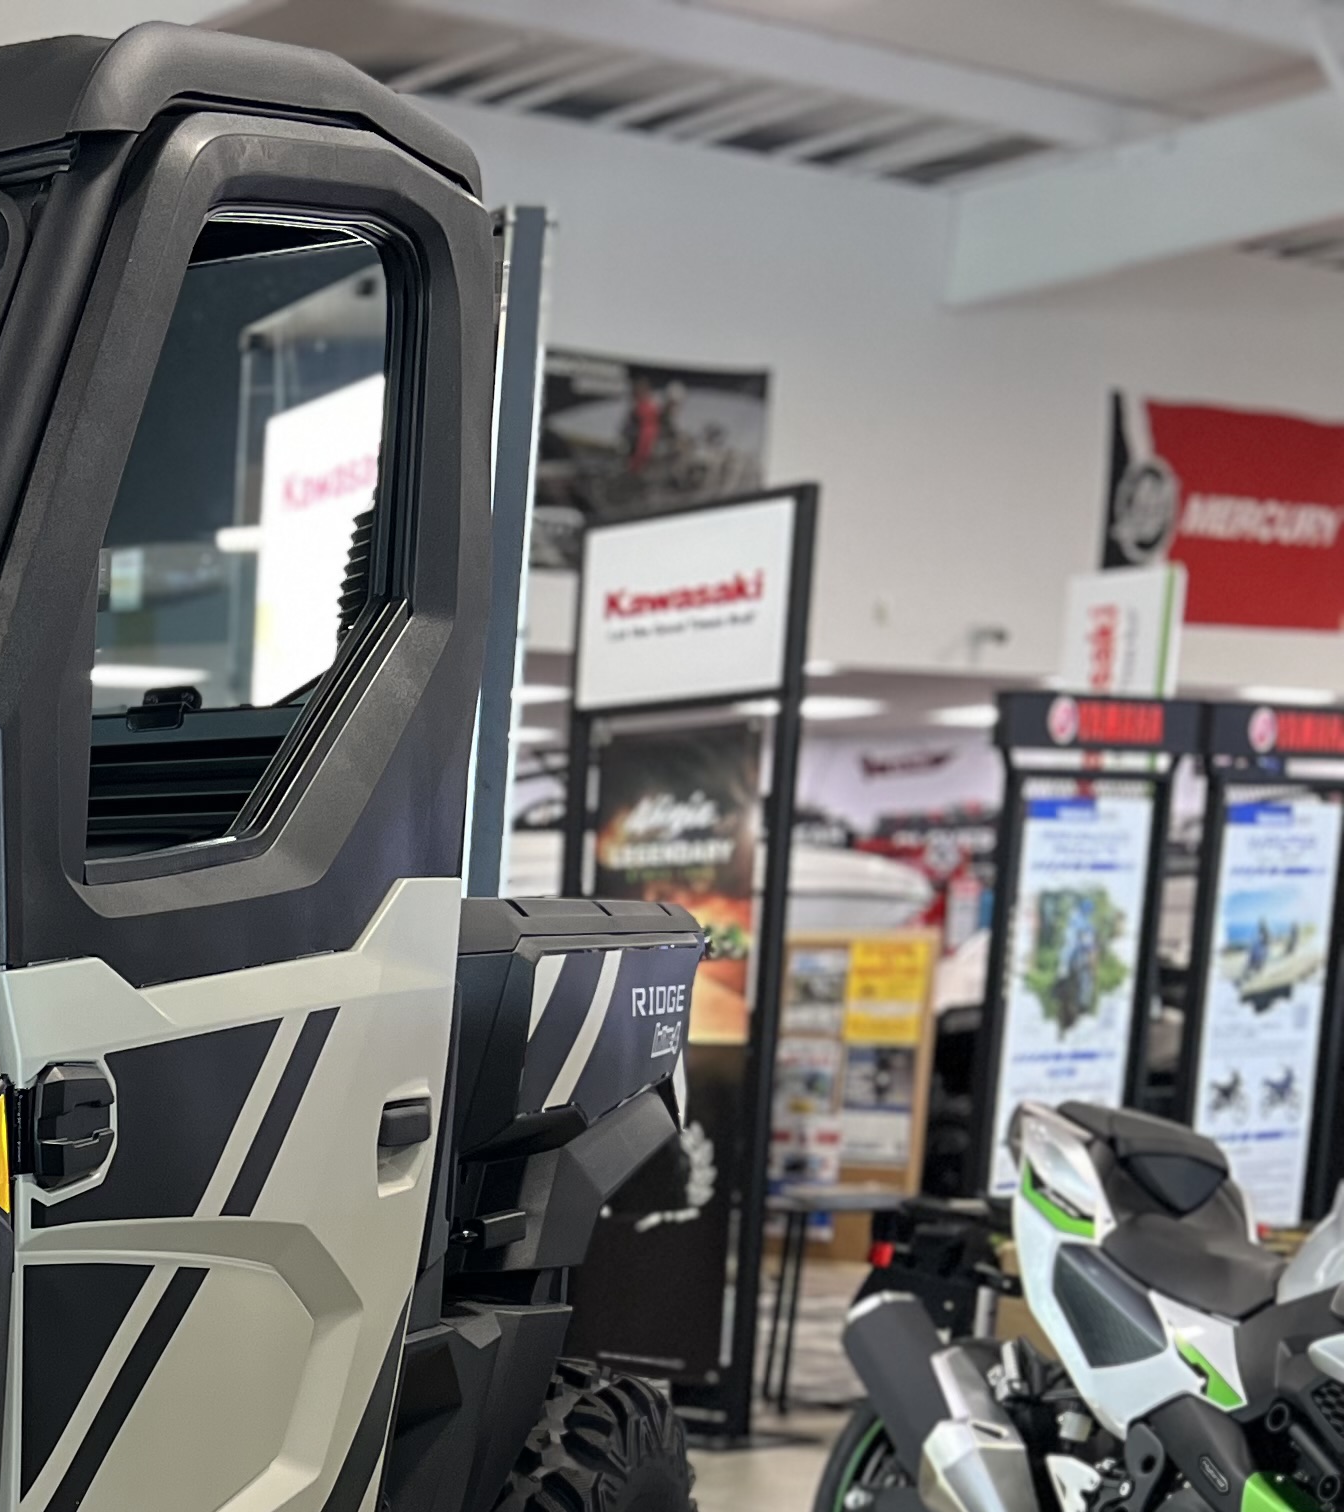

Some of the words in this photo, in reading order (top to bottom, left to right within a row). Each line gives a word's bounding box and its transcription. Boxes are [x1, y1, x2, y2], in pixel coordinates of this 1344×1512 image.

[1180, 493, 1341, 549] MERCURY
[604, 568, 765, 622] Kawasaki
[1078, 699, 1164, 744] YAMAHA
[610, 838, 734, 869] LEGENDARY
[631, 984, 686, 1017] RIDGE
